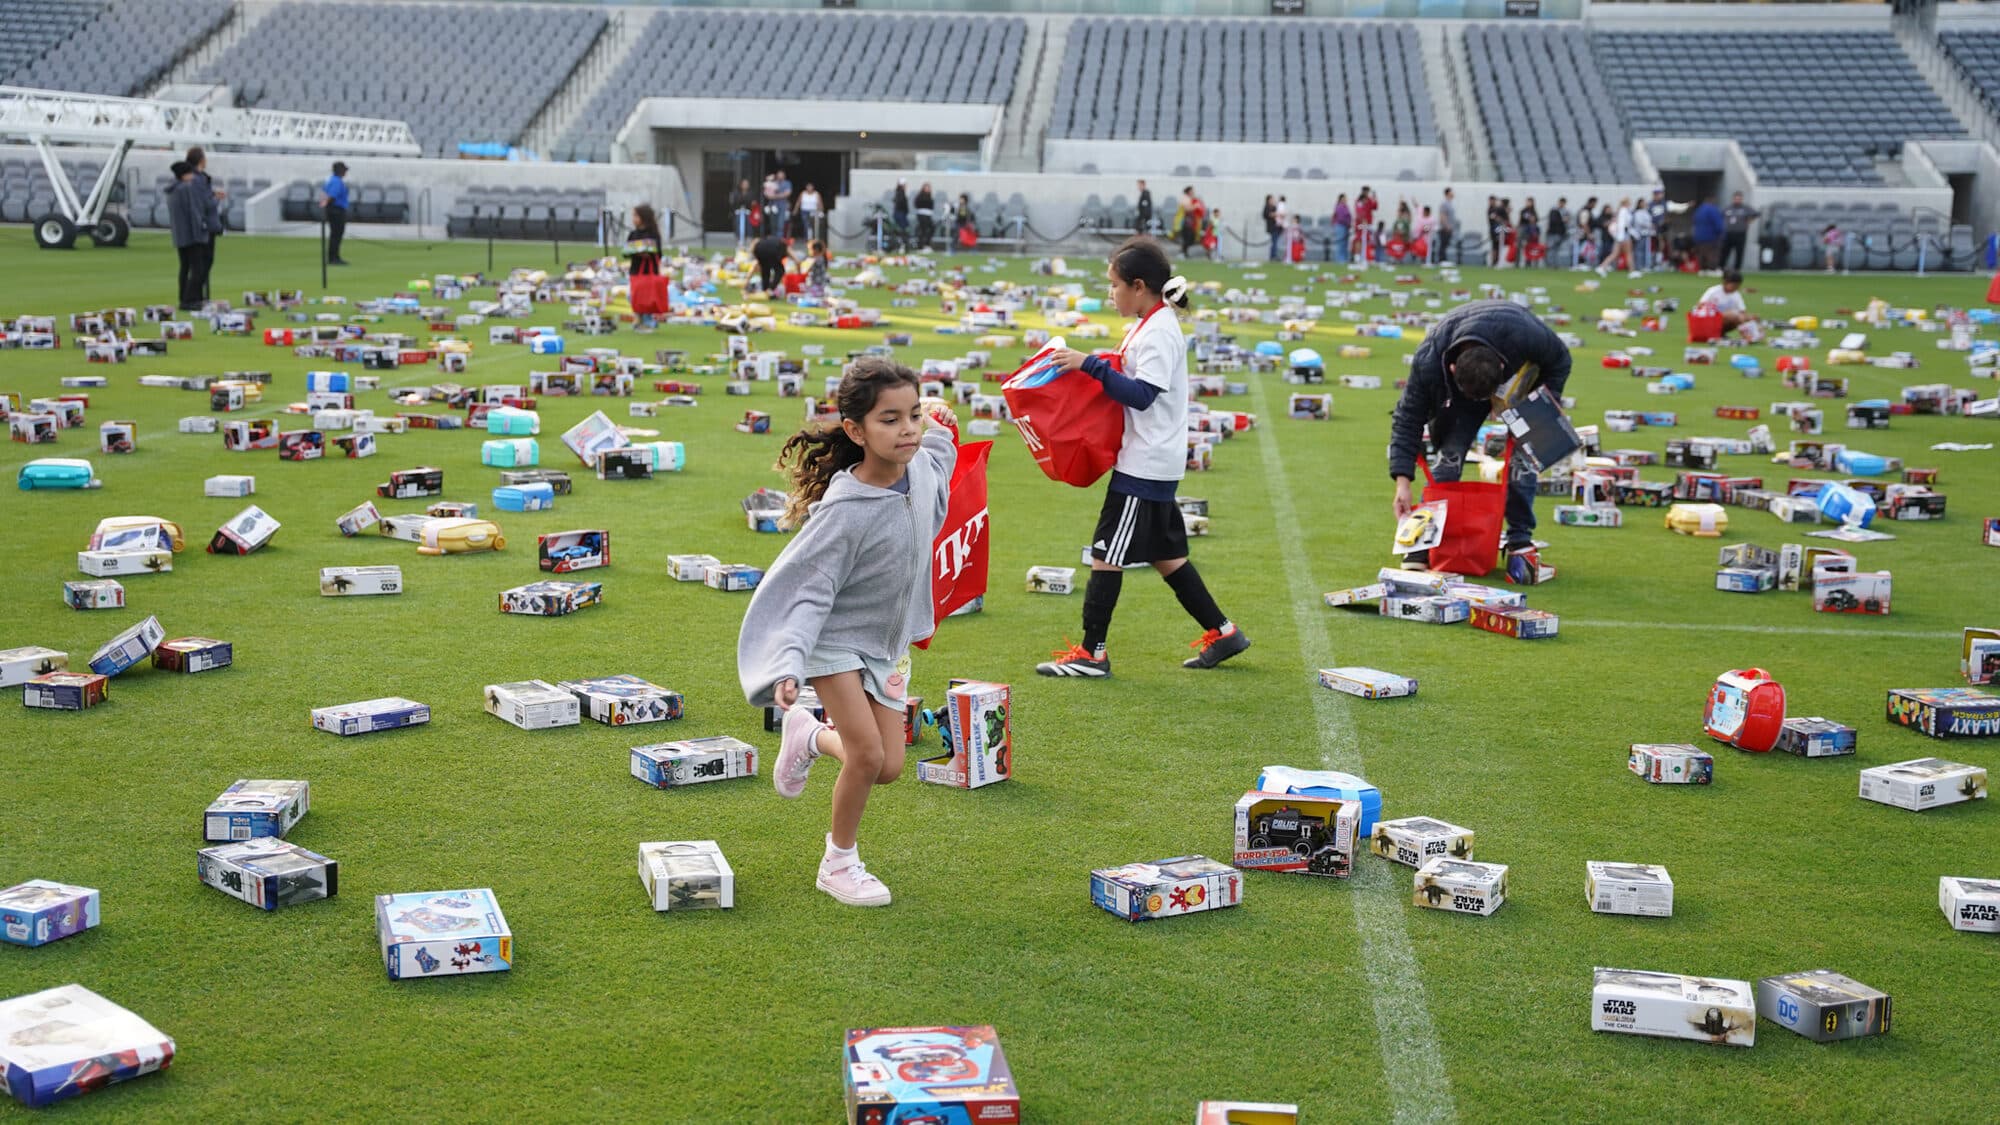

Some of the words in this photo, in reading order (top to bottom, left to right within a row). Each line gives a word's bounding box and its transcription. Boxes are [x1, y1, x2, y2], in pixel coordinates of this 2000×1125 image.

[1272, 819, 1298, 829] POLICE
[1425, 840, 1447, 849] STAR
[1237, 851, 1263, 860] FORD
[1425, 846, 1447, 856] WARS
[1454, 895, 1485, 905] WARS
[1454, 901, 1485, 912] STAR
[1961, 904, 1999, 913] STAR
[1961, 911, 1999, 921] WARS
[1603, 1000, 1636, 1009] STAR
[1603, 1007, 1636, 1015] WARS
[1779, 1003, 1799, 1023] DC
